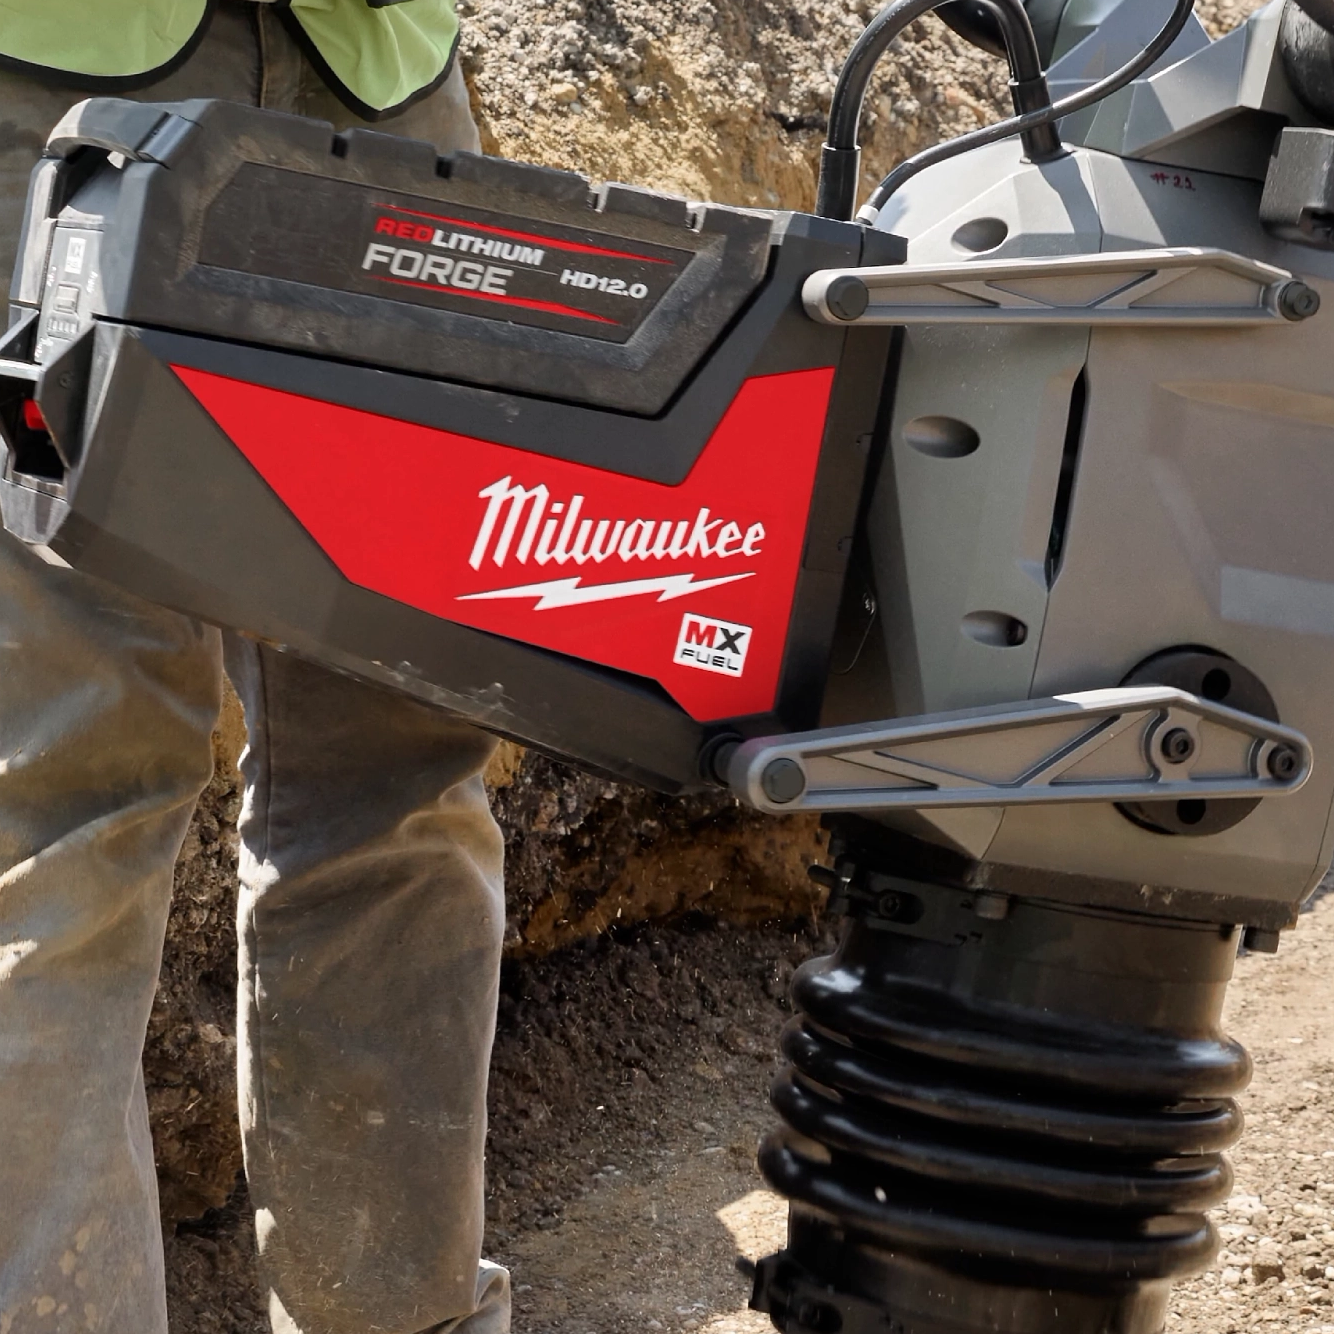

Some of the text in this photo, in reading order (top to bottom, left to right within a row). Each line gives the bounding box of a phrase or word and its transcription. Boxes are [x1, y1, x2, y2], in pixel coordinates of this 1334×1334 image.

[375, 216, 545, 266] REDLITHIUM
[361, 242, 514, 296] FORGE
[559, 269, 648, 300] HD12.0
[469, 475, 765, 571] Milwaukee
[685, 621, 746, 655] MX
[680, 648, 738, 671] FUEL
